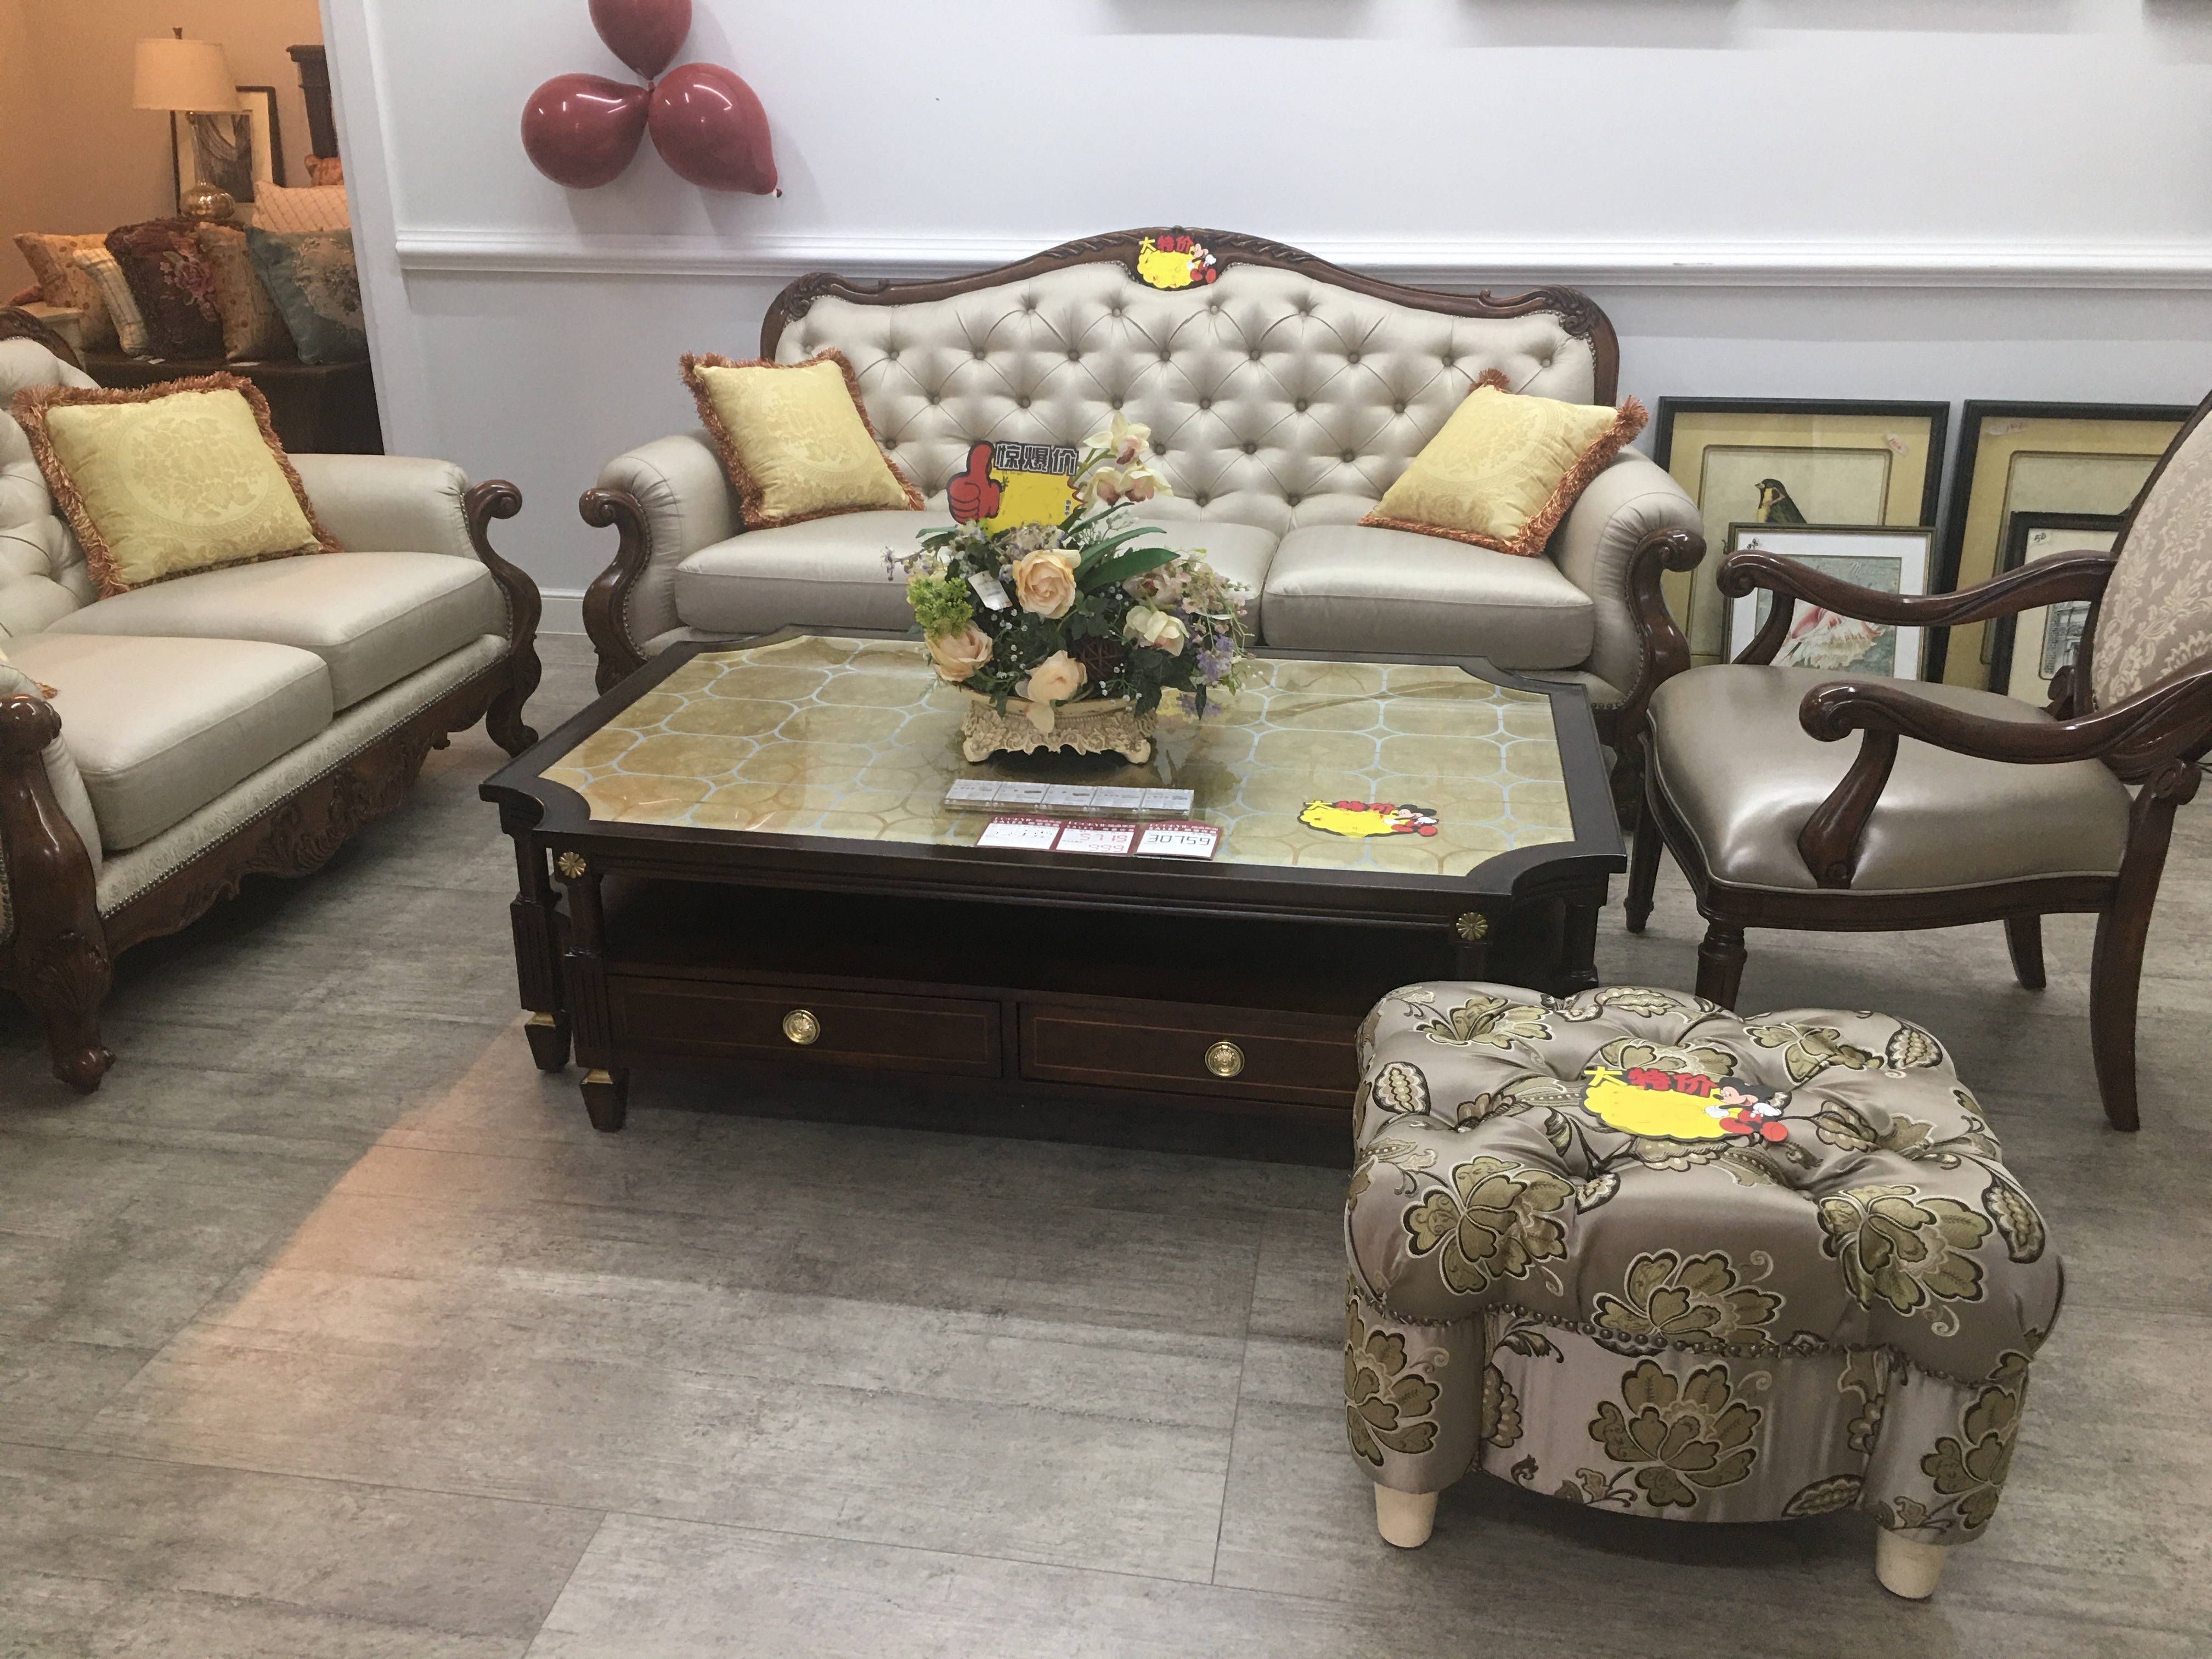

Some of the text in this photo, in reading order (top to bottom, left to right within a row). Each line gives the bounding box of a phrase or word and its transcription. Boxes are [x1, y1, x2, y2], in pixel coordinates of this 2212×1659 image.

[1138, 235, 1195, 255] 大特价
[995, 442, 1079, 476] 惊爆价
[2034, 532, 2047, 543] 50
[1148, 834, 1211, 845] 30759
[1583, 1066, 1719, 1098] 大特价
